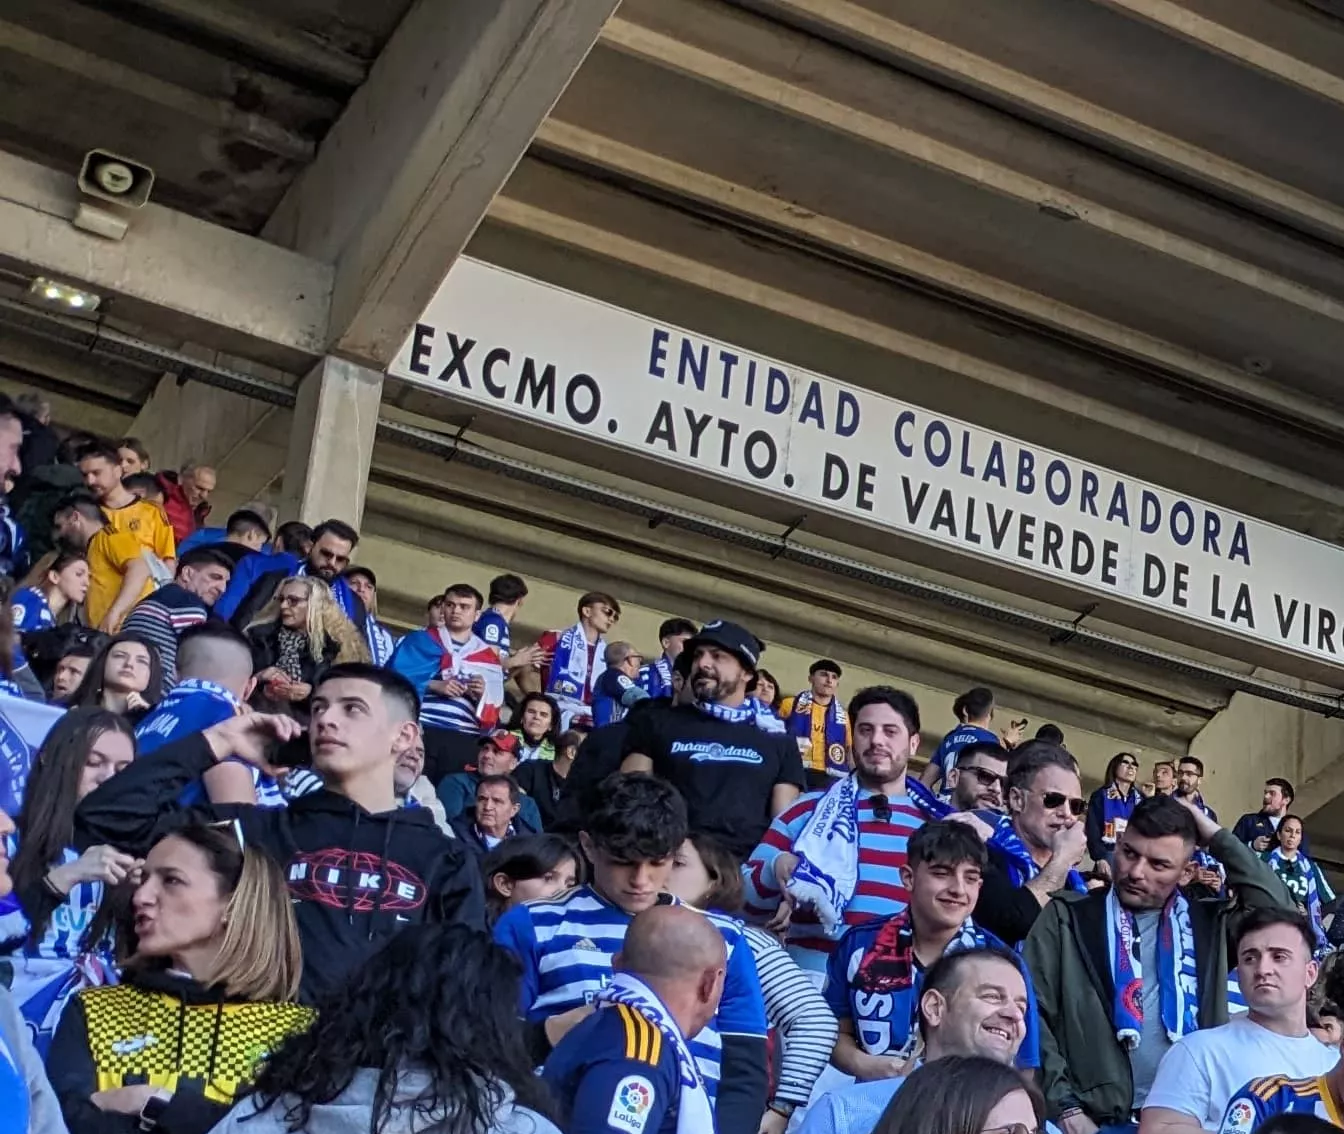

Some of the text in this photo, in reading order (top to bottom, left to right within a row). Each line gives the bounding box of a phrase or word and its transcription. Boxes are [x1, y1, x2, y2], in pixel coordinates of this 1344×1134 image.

[409, 323, 618, 434] EXCMO.
[646, 400, 794, 488] AYTO.
[822, 453, 876, 511] DE
[902, 475, 1119, 586] VALVERDE
[1142, 553, 1188, 608] DE
[1211, 574, 1255, 629] LA
[649, 328, 1251, 567] ENTIDAD COLABORADORA
[289, 863, 417, 900] NIKE
